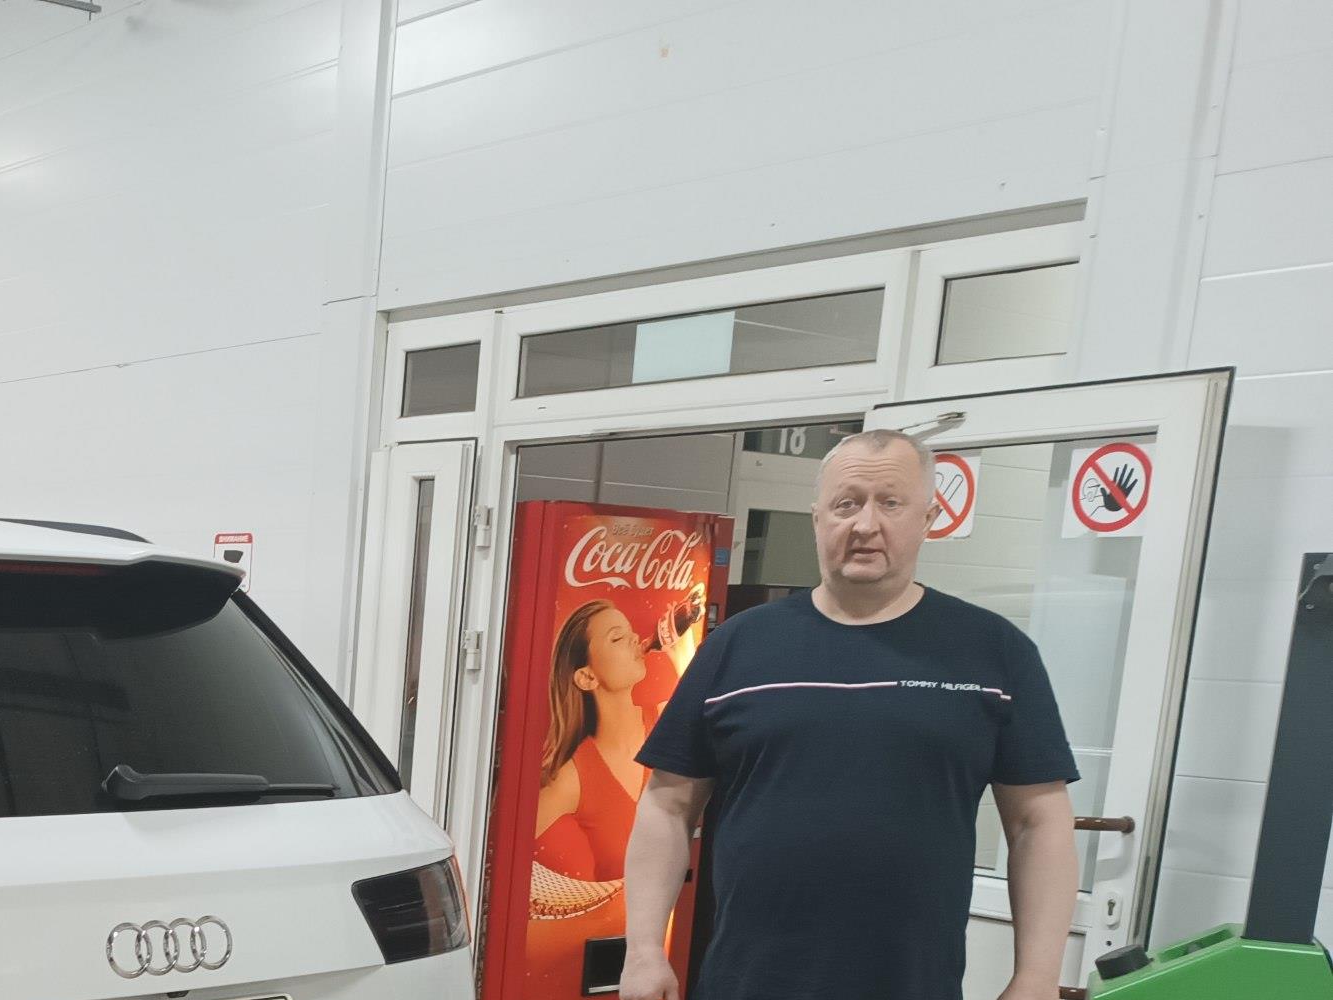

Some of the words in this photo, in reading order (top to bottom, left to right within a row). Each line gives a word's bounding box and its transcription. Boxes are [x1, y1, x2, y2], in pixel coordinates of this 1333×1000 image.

[565, 526, 702, 591] Coca-Cola
[900, 680, 938, 688] TOMMY
[940, 682, 981, 691] HILFIGER
